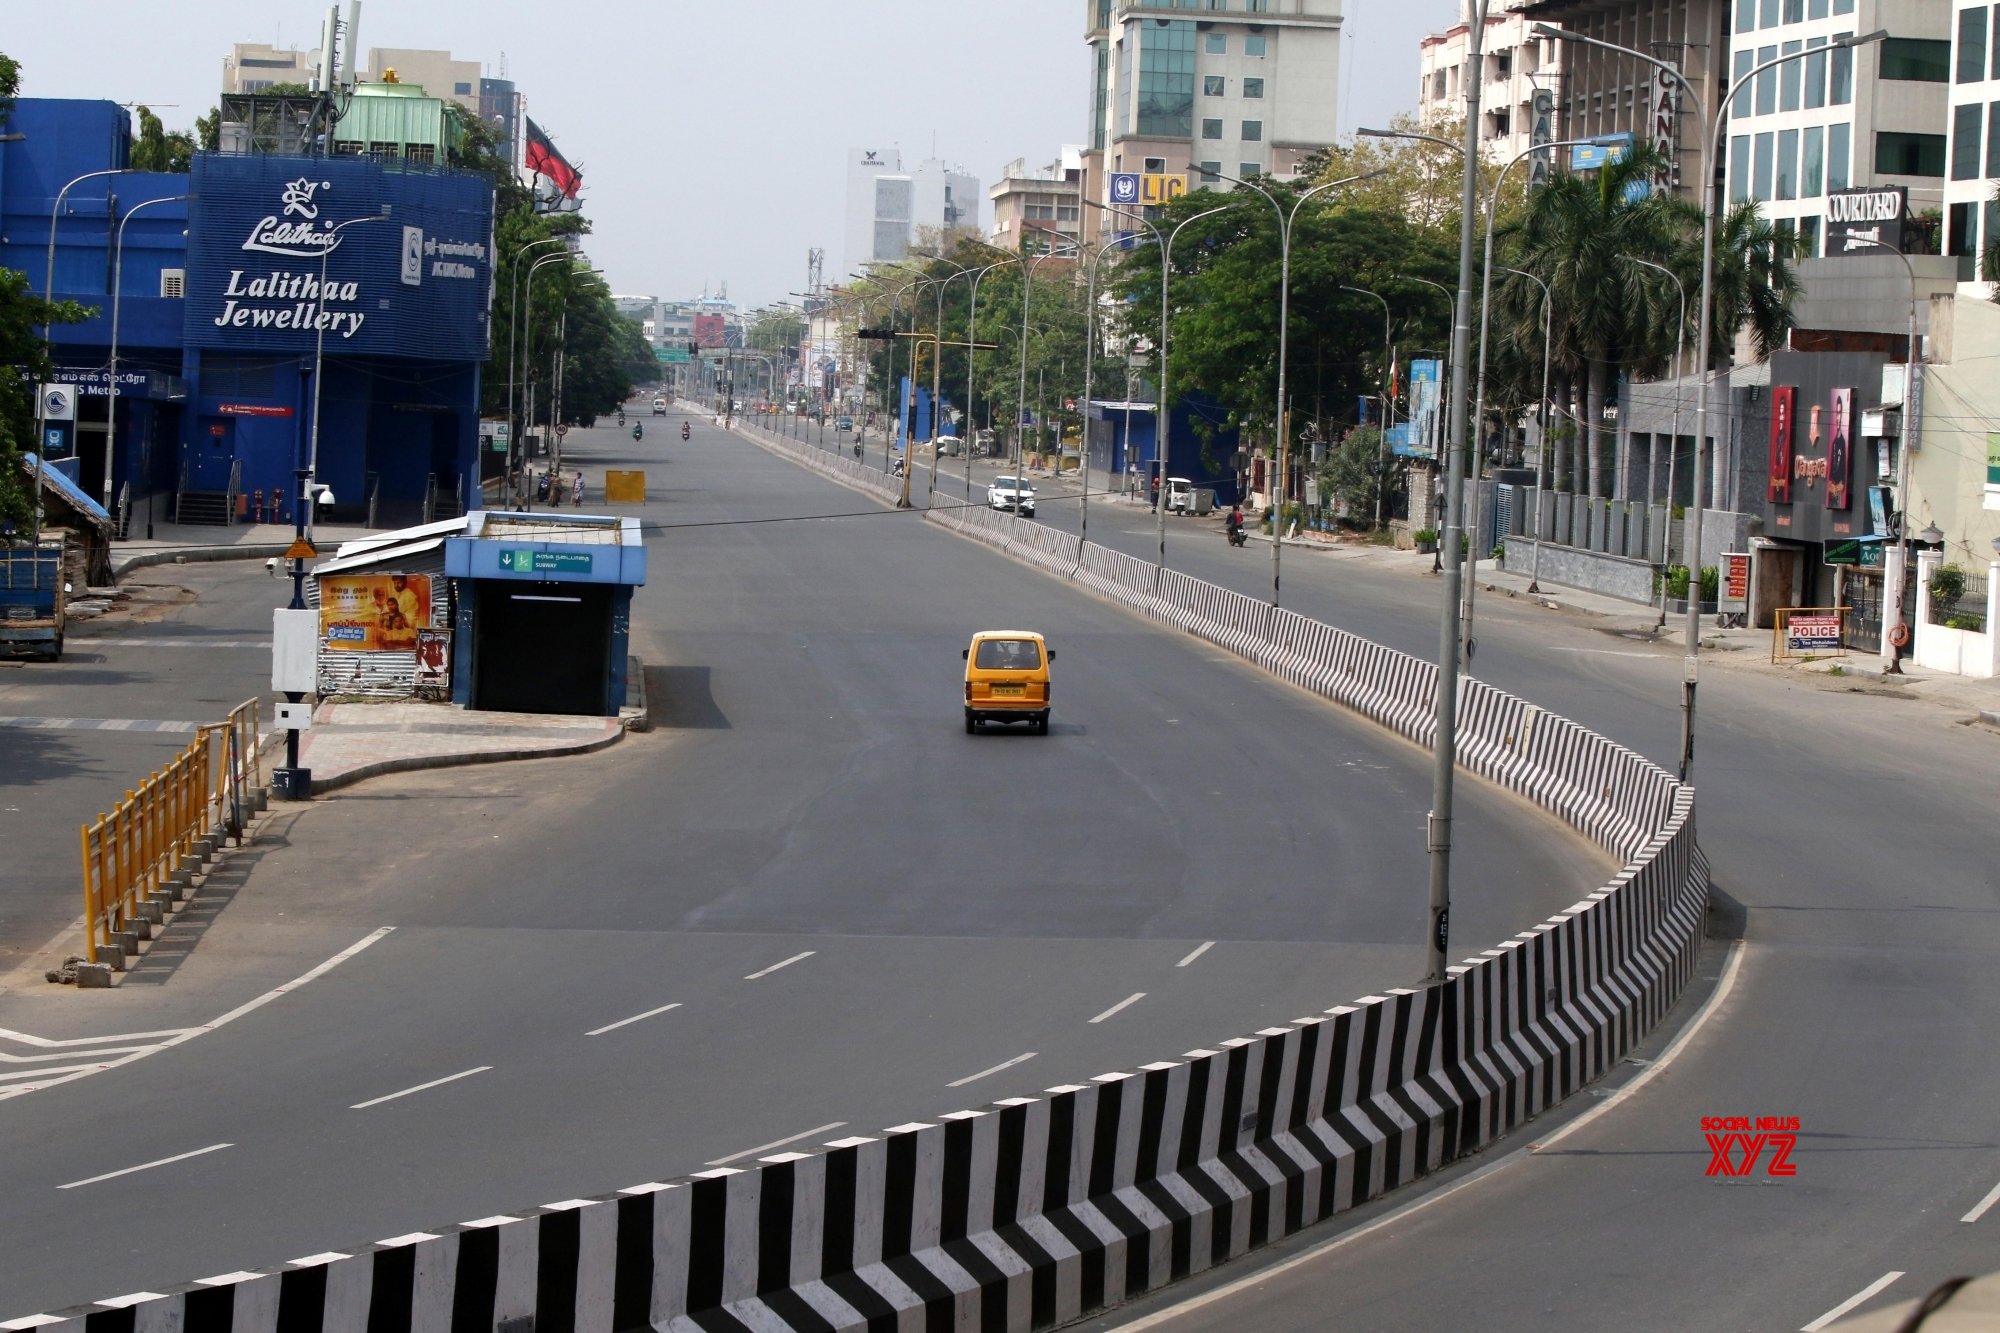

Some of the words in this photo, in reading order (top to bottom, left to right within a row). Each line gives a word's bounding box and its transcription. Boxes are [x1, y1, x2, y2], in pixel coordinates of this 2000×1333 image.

[1143, 177, 1182, 202] LIC
[1827, 191, 1901, 223] COURTYARD
[223, 270, 359, 301] Lalithaa
[214, 300, 365, 338] Jewellery
[558, 424, 566, 432] 40
[1793, 626, 1836, 636] POLICE
